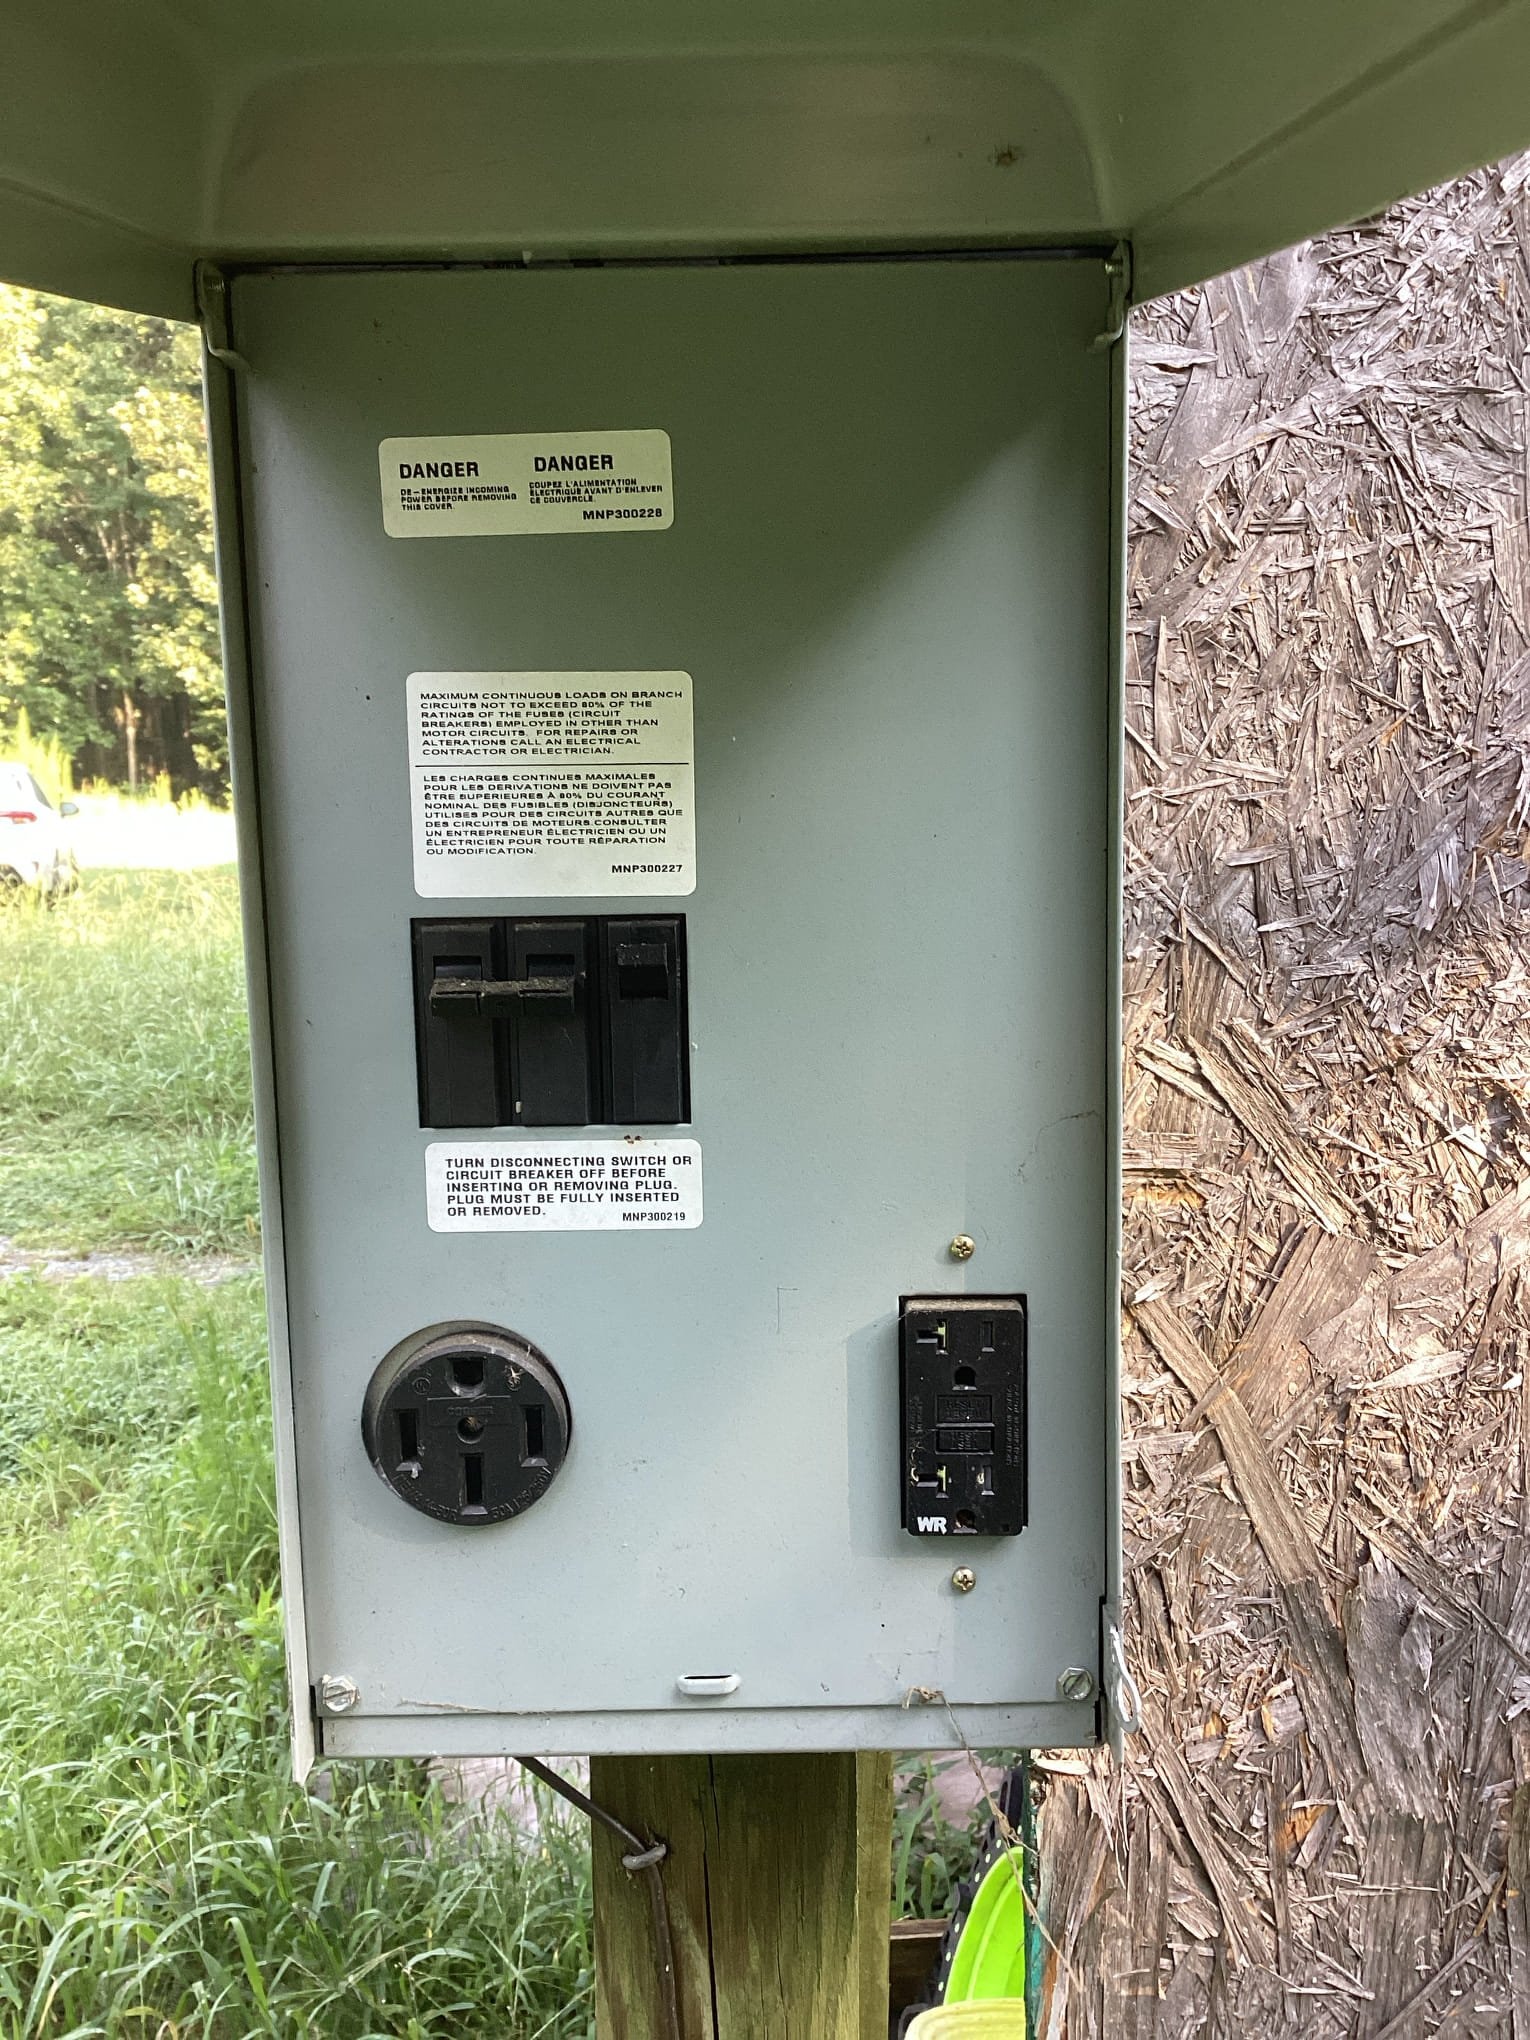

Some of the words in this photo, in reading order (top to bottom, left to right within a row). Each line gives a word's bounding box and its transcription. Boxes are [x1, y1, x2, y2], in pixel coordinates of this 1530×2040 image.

[534, 454, 614, 472] DANGER
[399, 461, 479, 479] DANGER
[466, 485, 509, 494] INCOMING
[528, 481, 562, 490] COUPEZ
[584, 486, 613, 496] AVANT
[614, 485, 663, 494] D'ENLEVER
[400, 495, 432, 503] POWER
[435, 494, 468, 502] BEFORE
[471, 493, 517, 501] REMOVING
[529, 496, 541, 504] CE
[582, 508, 662, 520] MNP300228
[565, 691, 607, 699] LOADS
[628, 700, 652, 708] THE
[568, 710, 621, 719] (CIRCUIT
[625, 718, 658, 726] THAN
[564, 728, 617, 736] REPAIRS
[620, 728, 638, 736] OR
[510, 738, 542, 746] CALL
[566, 737, 641, 745] ELECTRICAL
[531, 747, 614, 755] ELECTRICIAN.
[592, 782, 645, 790] DOIVENT
[424, 792, 455, 800] ÊTRE
[547, 791, 556, 799] À
[606, 791, 666, 800] COURANT
[483, 802, 507, 810] DES
[572, 800, 673, 809] (DISJONCTEURS)
[605, 809, 654, 817] AUTRES
[546, 828, 625, 836] ÉLECTRICIEN
[426, 838, 504, 846] ÉLECTRICIEN
[588, 836, 666, 844] RÉPARATION
[611, 864, 683, 873] MNP300227
[445, 1158, 484, 1168] TURN
[490, 1156, 605, 1167] DISCONNECTING
[611, 1155, 666, 1166] SWITCH
[672, 1155, 692, 1165] OR
[446, 1170, 503, 1180] CIRCUIT
[508, 1169, 573, 1179] BREAKER
[579, 1168, 605, 1178] OFF
[611, 1168, 666, 1178] BEFORE
[446, 1182, 522, 1192] INSERTING
[528, 1182, 548, 1191] OR
[554, 1180, 629, 1191] REMOVING
[635, 1180, 677, 1190] PLUG.
[447, 1194, 484, 1204] PLUG
[490, 1194, 531, 1204] MUST
[537, 1194, 554, 1203] BE
[560, 1193, 604, 1203] FULLY
[610, 1192, 679, 1202] INSERTED
[447, 1207, 466, 1216] OR
[472, 1206, 546, 1216] REMOVED.
[622, 1212, 686, 1221] MNP300219
[916, 1516, 948, 1535] WR
